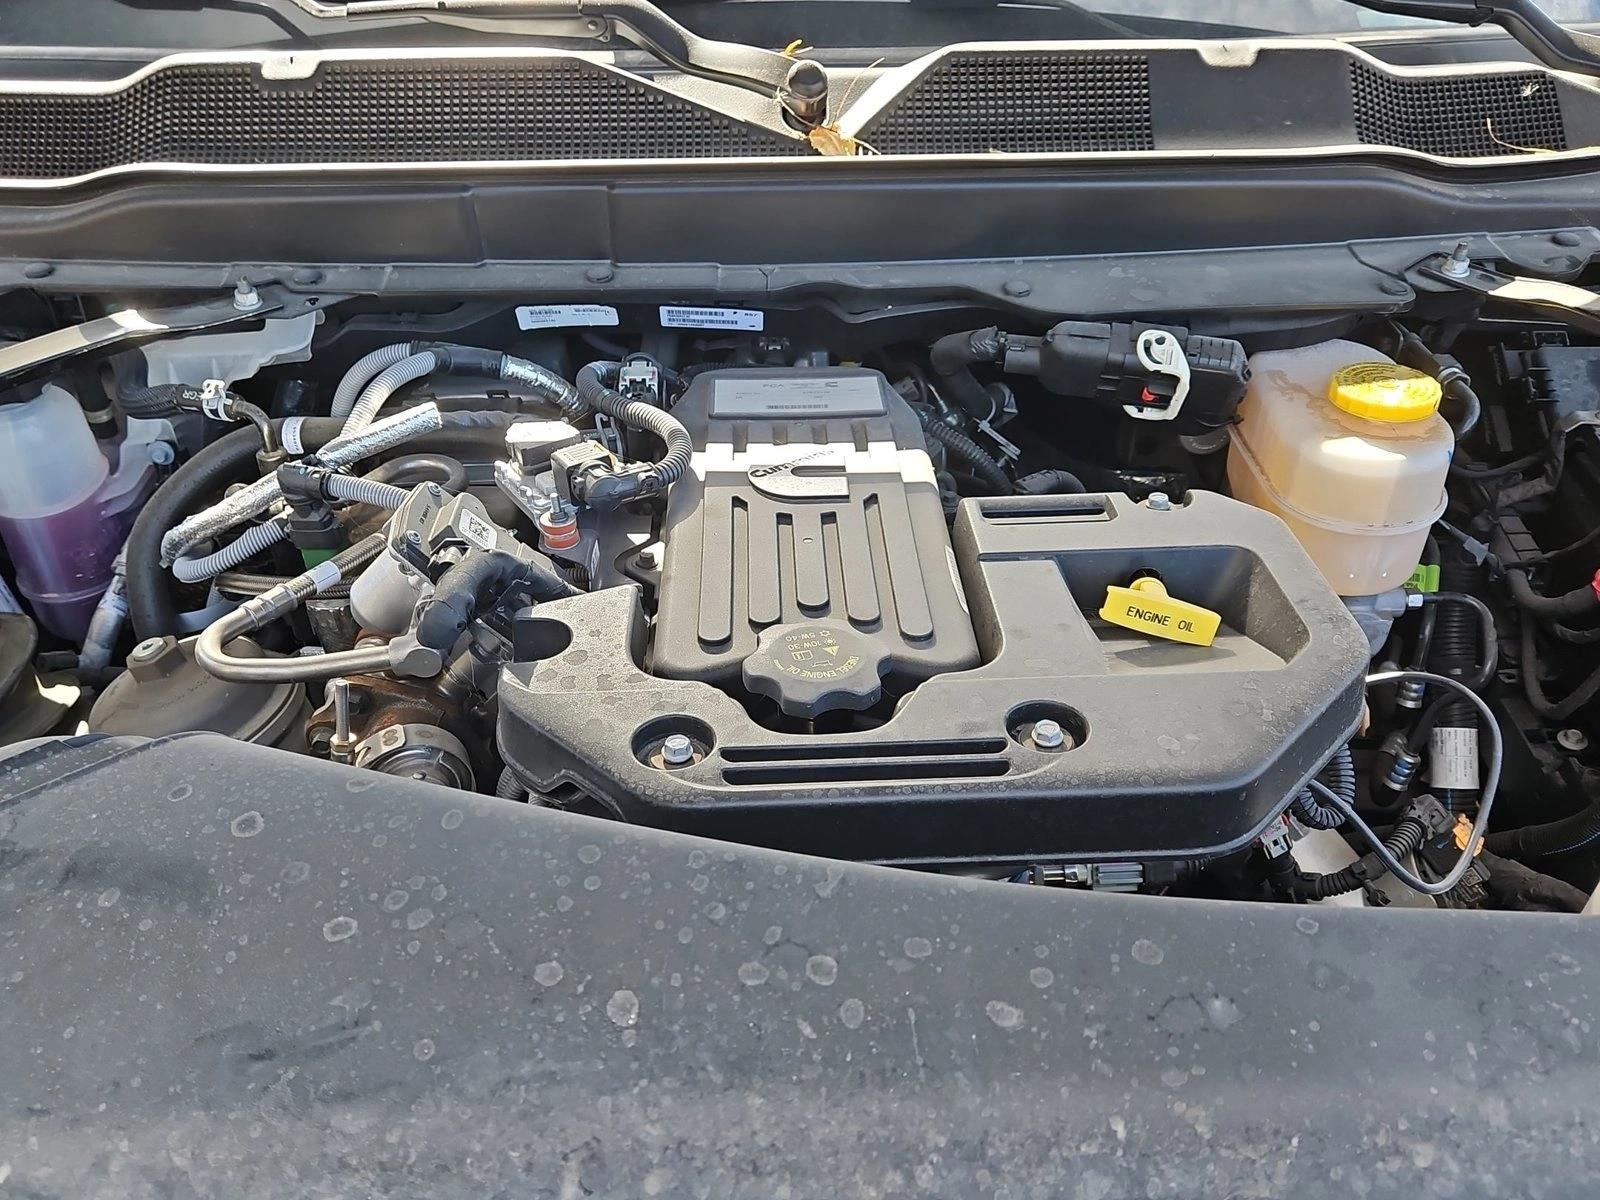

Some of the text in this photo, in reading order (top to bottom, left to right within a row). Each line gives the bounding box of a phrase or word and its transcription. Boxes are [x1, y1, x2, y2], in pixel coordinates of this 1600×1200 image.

[1126, 606, 1195, 633] ENGINE OIL
[785, 632, 816, 642] 5W-40
[787, 640, 821, 651] 10W-30
[786, 664, 801, 675] OIL
[800, 669, 837, 679] ENGINE
